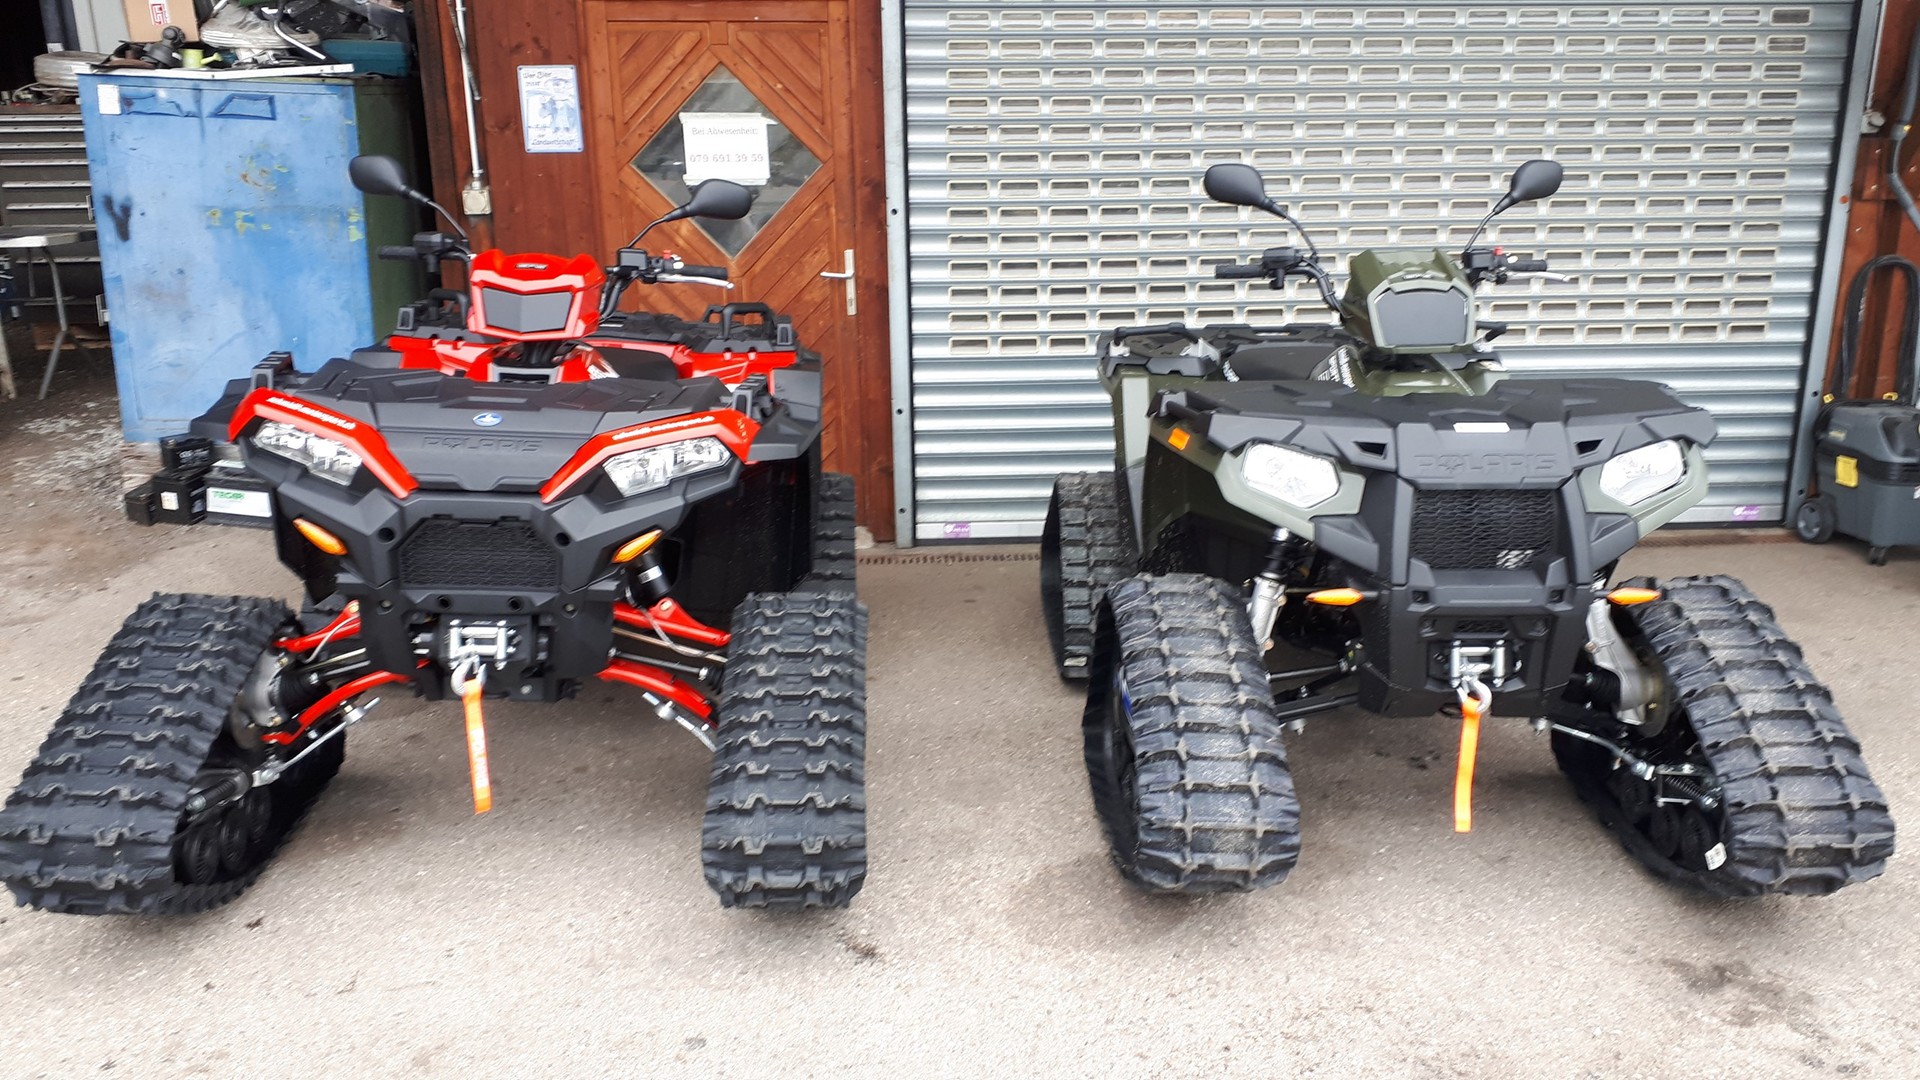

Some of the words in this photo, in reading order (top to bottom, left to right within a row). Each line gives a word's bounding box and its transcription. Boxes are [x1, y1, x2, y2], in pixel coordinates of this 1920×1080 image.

[691, 127, 705, 135] Bei
[689, 153, 709, 163] 079
[712, 153, 731, 163] 691
[735, 153, 748, 162] 39
[751, 153, 764, 162] 59
[422, 435, 543, 453] POLARIS
[1412, 453, 1557, 476] POLARIS
